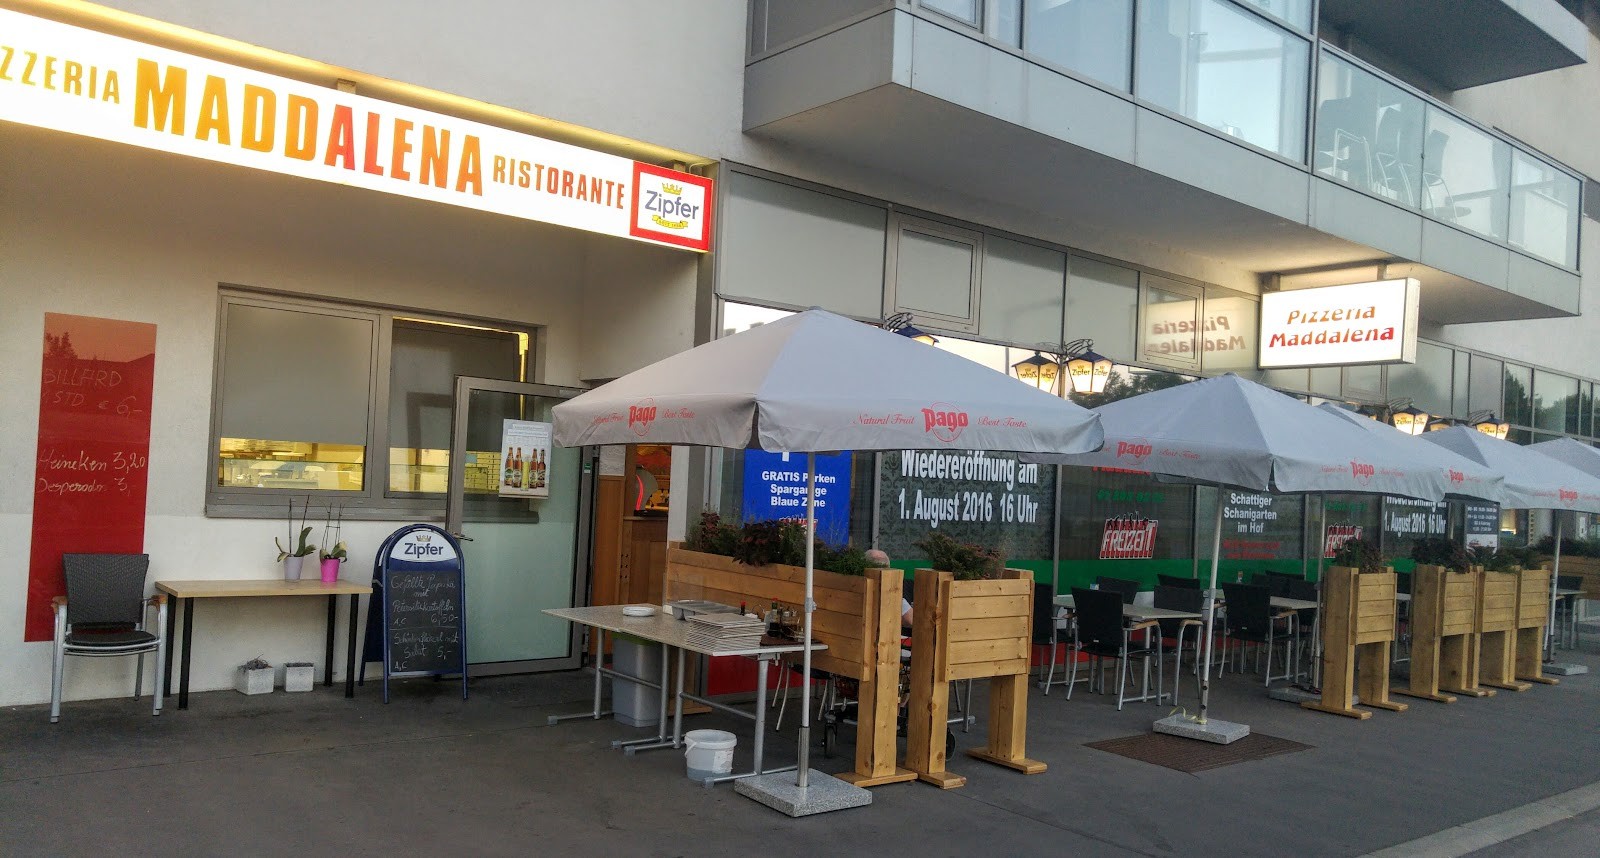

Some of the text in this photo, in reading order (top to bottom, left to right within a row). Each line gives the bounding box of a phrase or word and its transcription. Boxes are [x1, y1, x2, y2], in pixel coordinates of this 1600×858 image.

[133, 57, 483, 197] MADDALENA
[493, 154, 625, 209] RISTORANTE
[644, 189, 700, 219] Zipfer
[1287, 305, 1375, 325] Pizzeria
[1269, 326, 1394, 348] Maddalena
[43, 368, 122, 387] BILLARD
[53, 391, 84, 406] STD
[628, 405, 657, 429] pago
[852, 408, 1028, 433] Natural Fruit pago Best Taste
[1116, 441, 1153, 458] pago
[37, 449, 146, 474] Heineken 3,20
[901, 450, 1038, 491] Wiedereröffnung am
[1350, 461, 1375, 479] pago
[761, 471, 836, 484] GRATIS Prken
[770, 496, 826, 508] Blaue Zne
[898, 488, 1039, 529] 1. August 2016 16 Uhr
[1230, 492, 1272, 508] Schattiger
[1223, 507, 1278, 521] Schanigarten
[1237, 521, 1265, 533] im Hof
[1390, 512, 1411, 538] August
[1411, 512, 1426, 533] 2016
[1428, 513, 1436, 534] 16
[1436, 514, 1447, 534] Uhr
[404, 542, 444, 559] Zipfer
